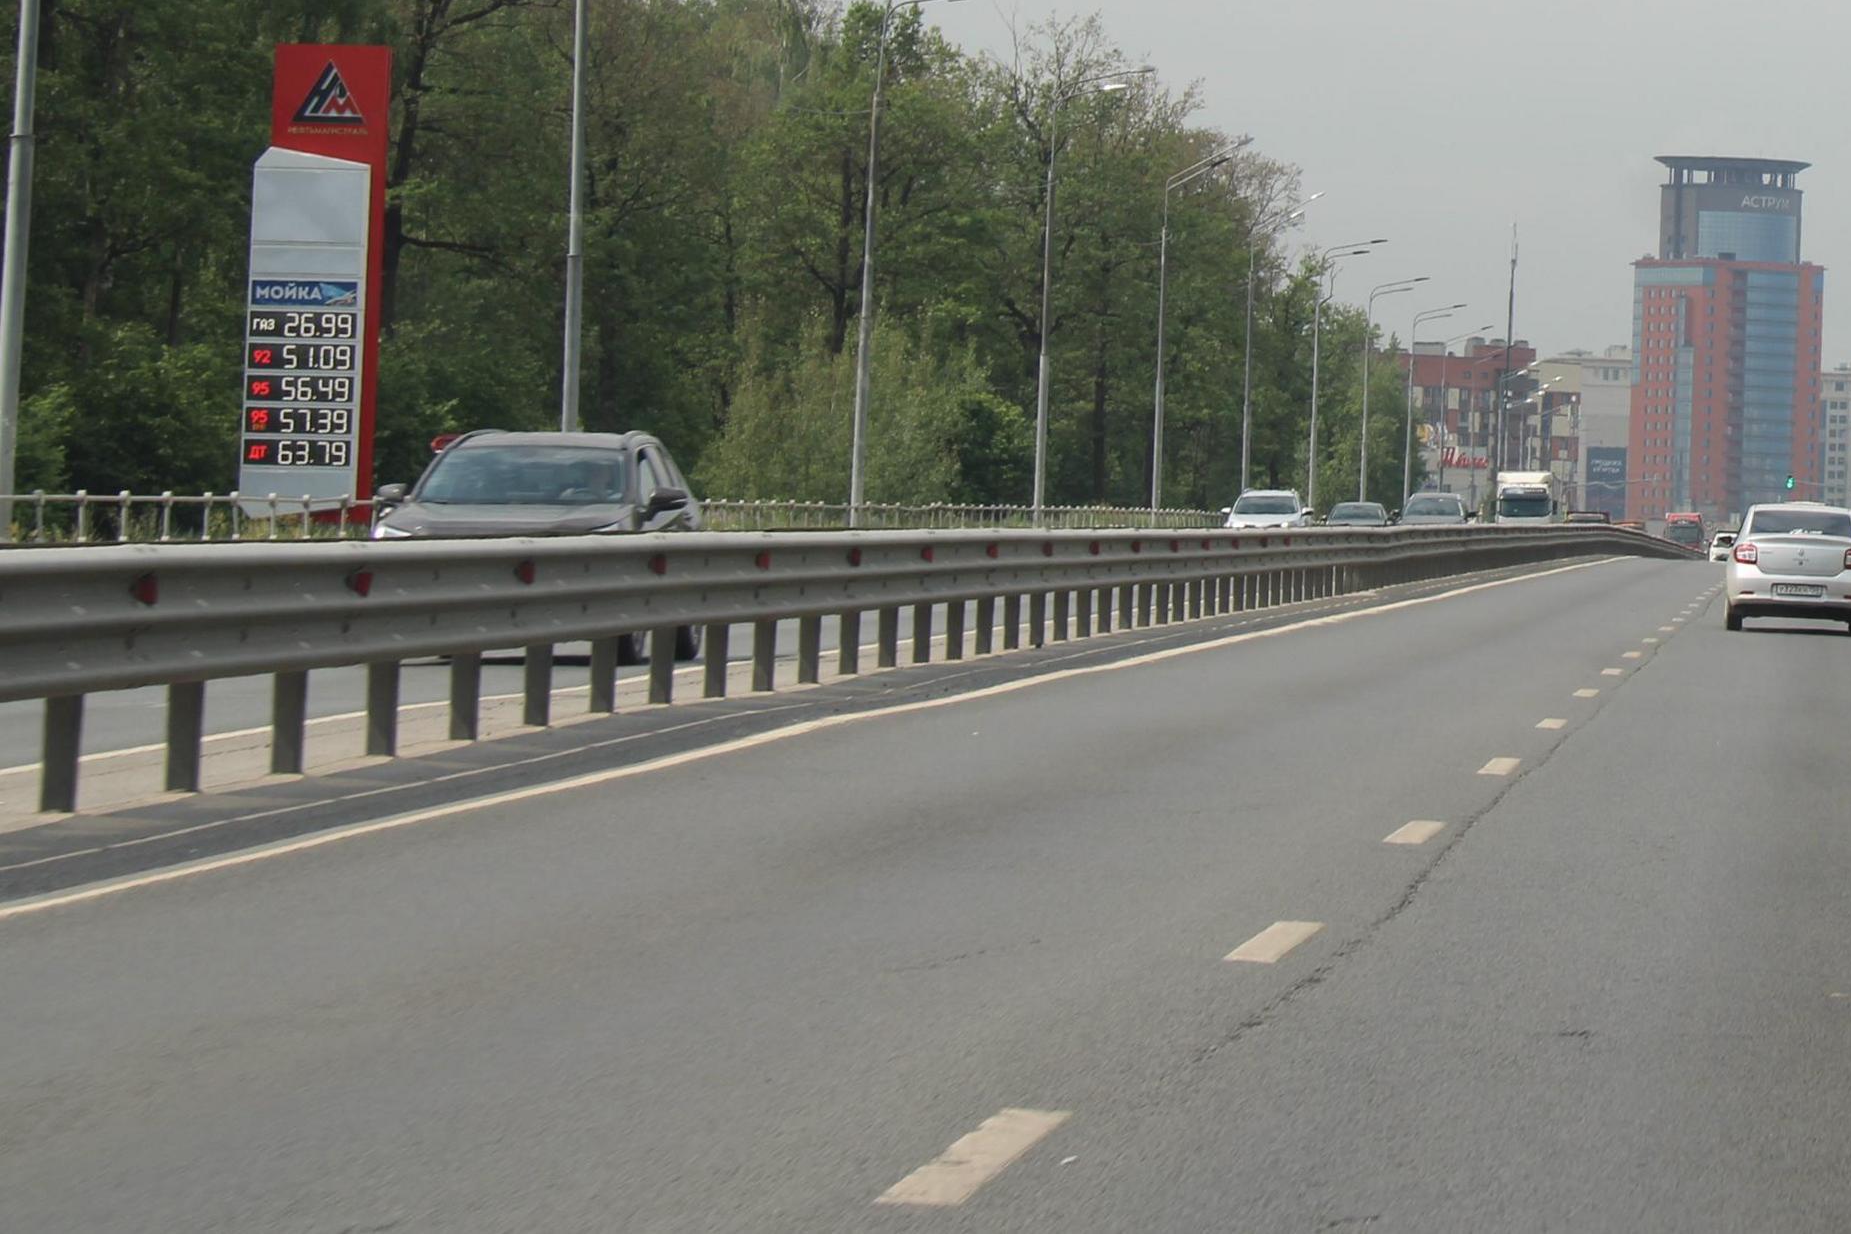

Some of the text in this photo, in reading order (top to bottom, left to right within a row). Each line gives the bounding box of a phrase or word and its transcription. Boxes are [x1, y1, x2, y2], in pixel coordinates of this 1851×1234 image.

[256, 283, 322, 300] МОЙКА
[253, 313, 352, 338] ГАЗ 26.99
[254, 345, 350, 369] 92 51.09
[252, 377, 349, 402] 95 56.49
[251, 409, 347, 433] 95 57.39
[249, 441, 346, 465] ДТ 63.79
